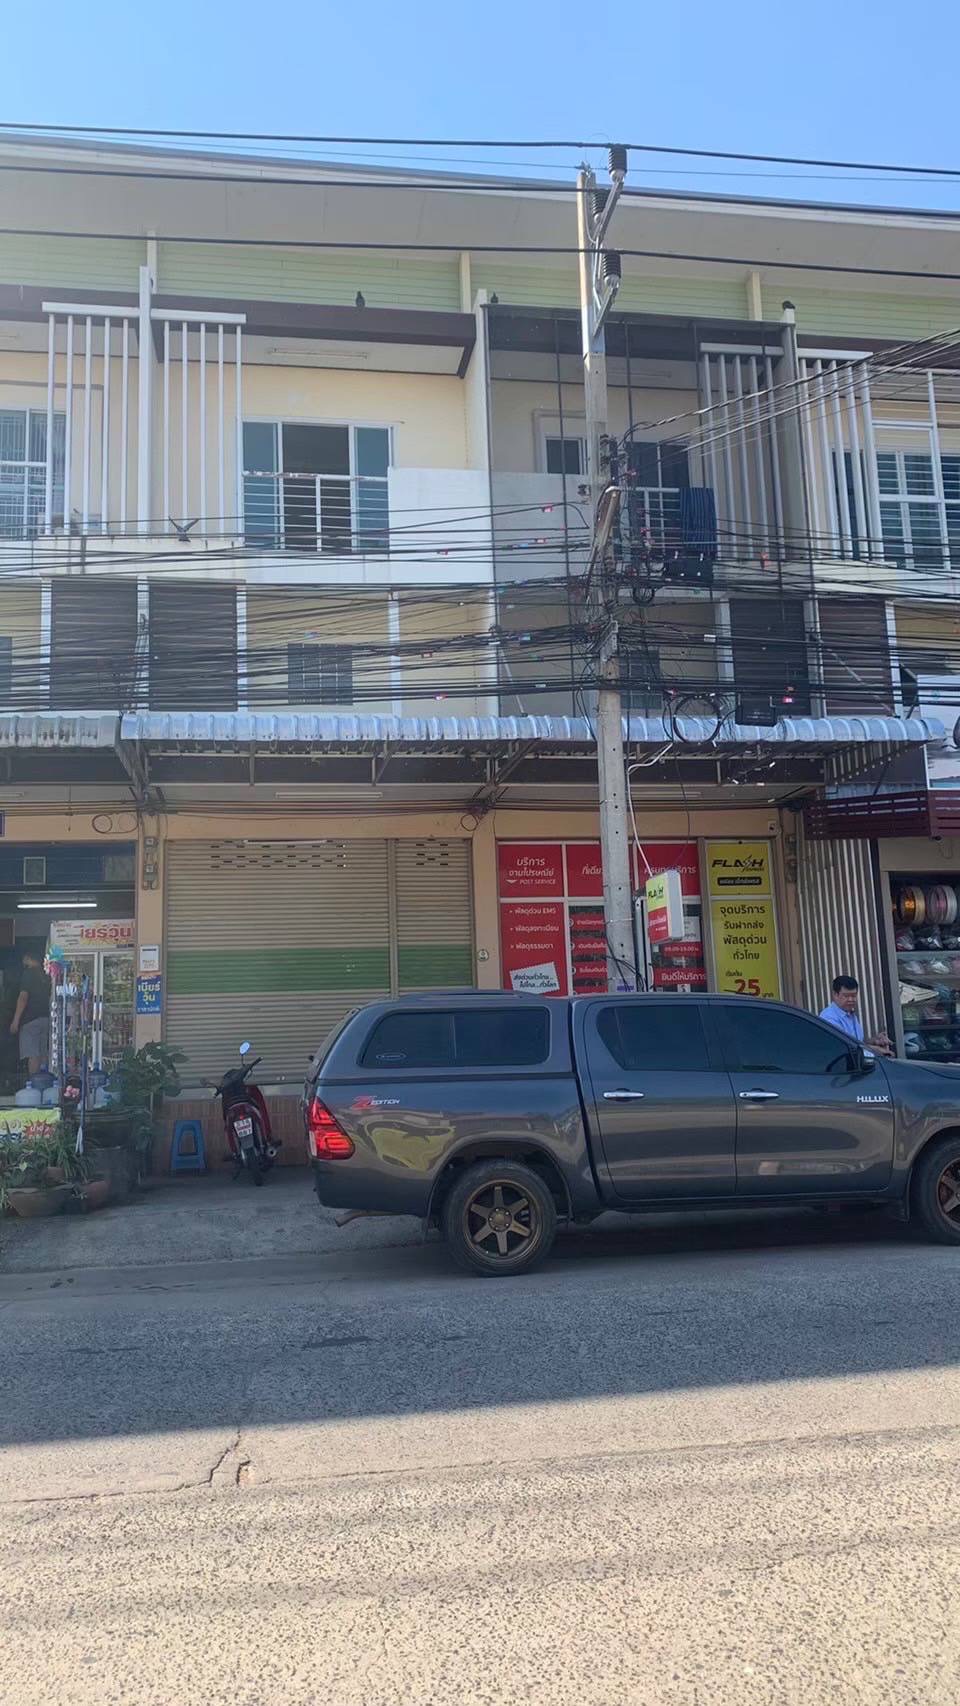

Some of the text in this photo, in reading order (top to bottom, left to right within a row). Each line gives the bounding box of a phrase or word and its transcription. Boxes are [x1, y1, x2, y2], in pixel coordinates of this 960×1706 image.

[517, 857, 545, 866] บริการ
[509, 868, 554, 877] งานไปรษณีย์
[582, 864, 603, 875] ที่เดีย
[720, 905, 766, 917] จุดบริการ
[724, 921, 765, 930] รับฝากส่ง
[723, 934, 767, 947] พัสดุด่วน
[733, 949, 760, 960] ทั่วไทย
[734, 979, 761, 997] 25
[856, 1095, 889, 1103] HILUX
